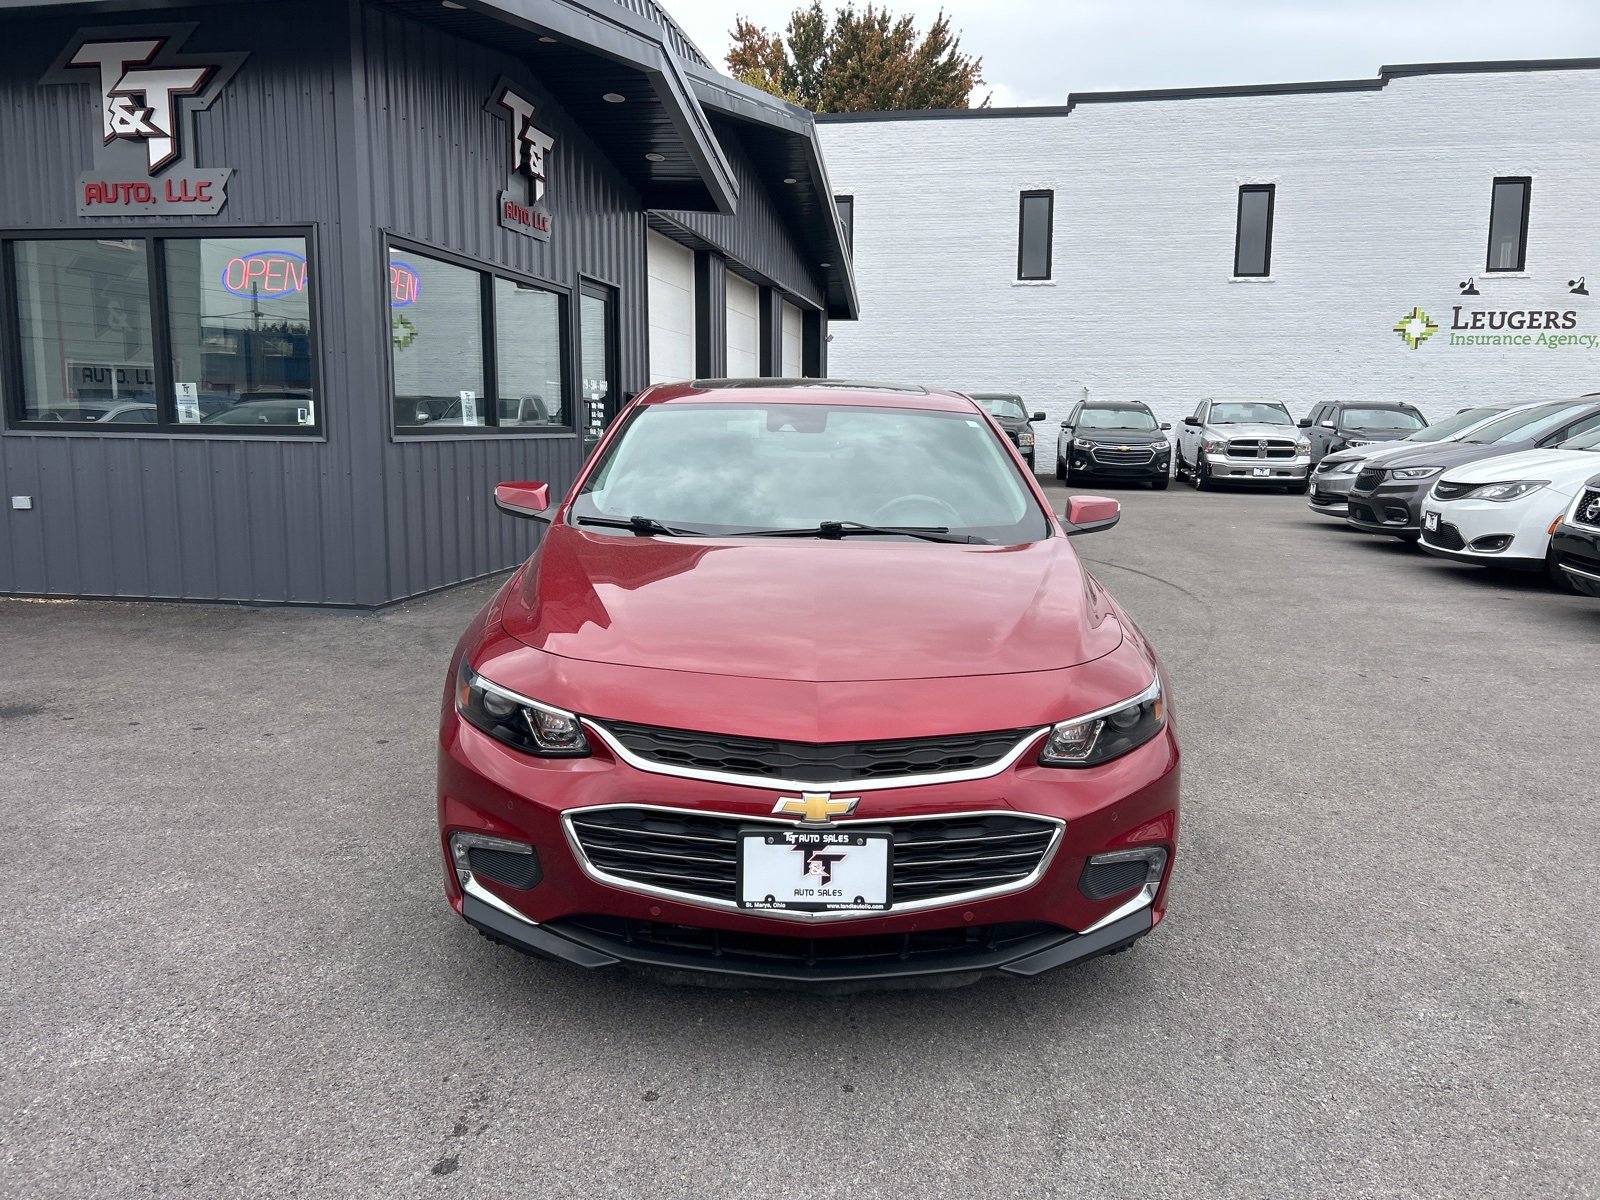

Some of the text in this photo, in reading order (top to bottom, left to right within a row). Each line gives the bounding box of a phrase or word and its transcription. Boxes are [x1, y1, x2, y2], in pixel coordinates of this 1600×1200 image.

[84, 178, 213, 206] AUTO, LLC
[532, 211, 551, 233] LLC
[225, 257, 307, 292] OPEN
[389, 266, 419, 303] PEN
[1450, 305, 1577, 331] LEUGERS
[1449, 332, 1600, 350] Insurance Agency,
[135, 367, 154, 386] LL
[799, 834, 820, 843] AUTO
[822, 834, 849, 844] SALES
[793, 888, 843, 898] AUTO SALES
